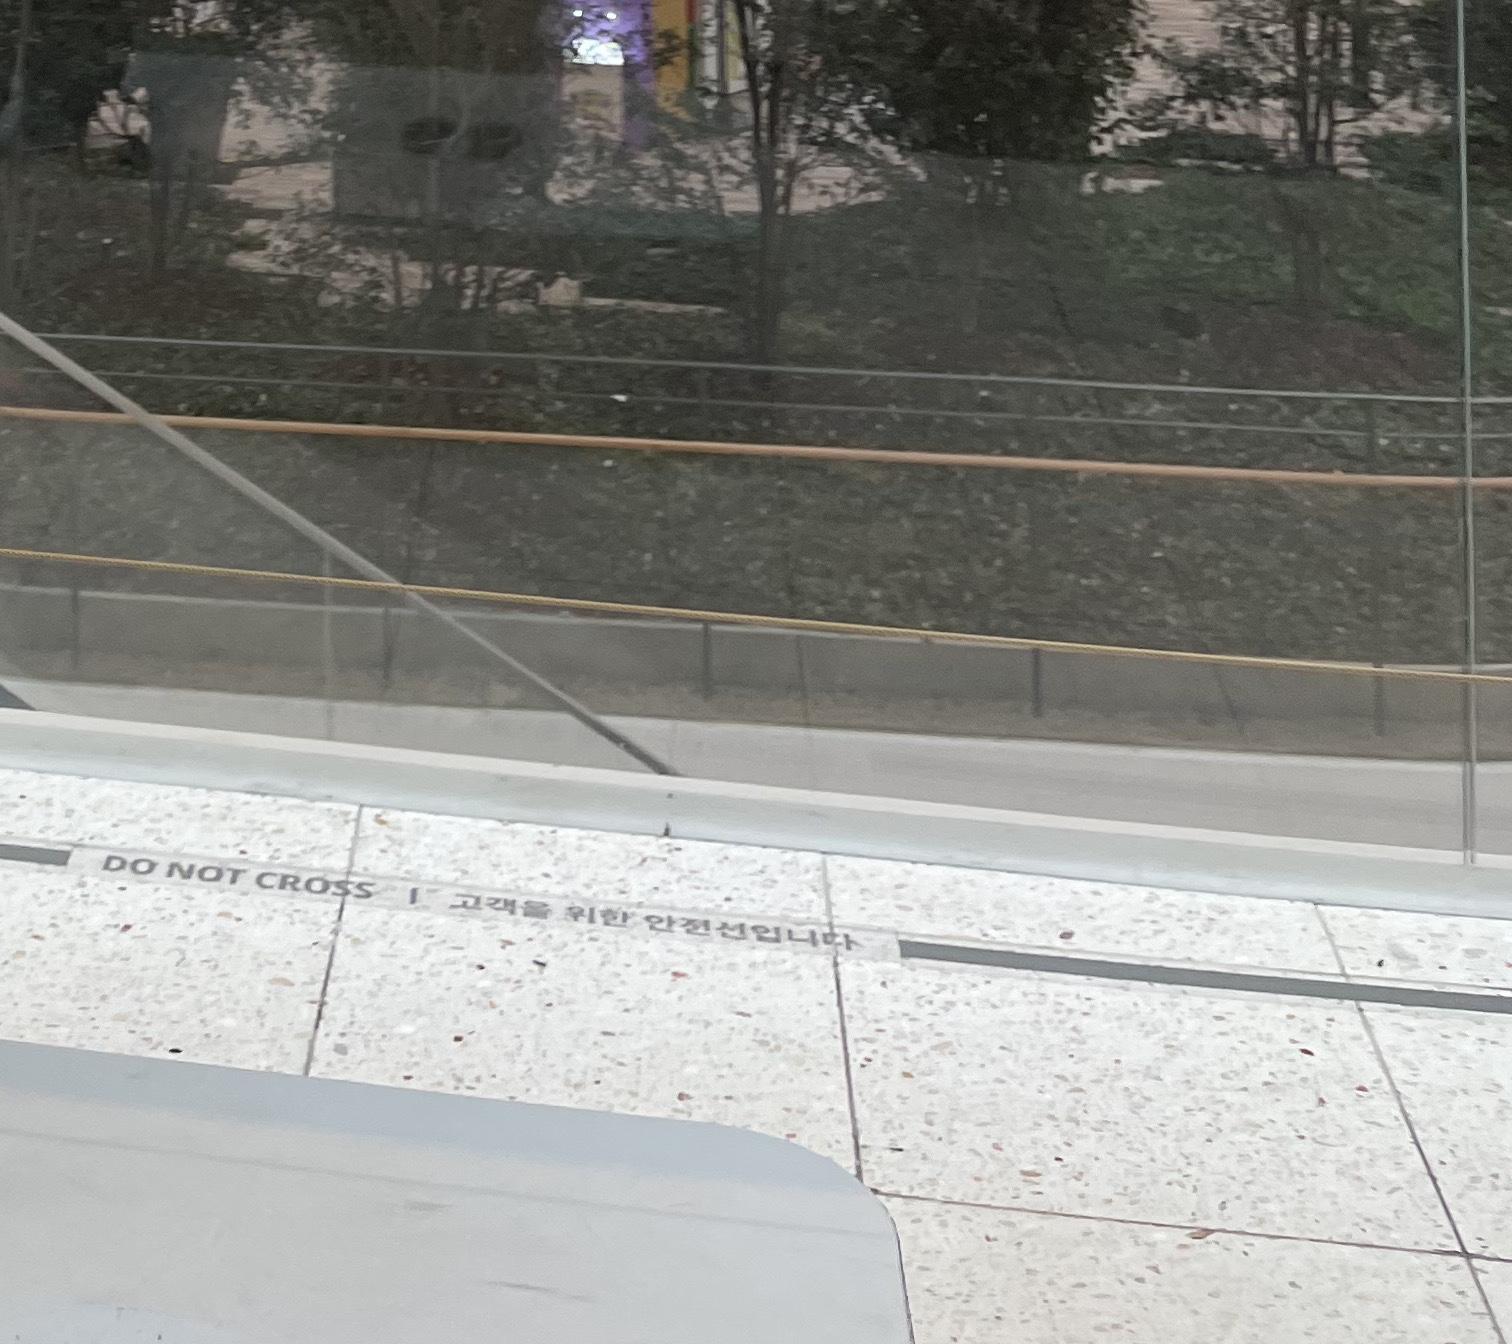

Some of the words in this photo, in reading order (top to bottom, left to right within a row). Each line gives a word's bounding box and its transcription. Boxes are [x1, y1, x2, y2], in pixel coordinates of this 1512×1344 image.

[101, 855, 159, 876] DO
[165, 862, 250, 885] NOT
[255, 872, 376, 900] CROSS
[644, 914, 866, 951] 안전선입니다
